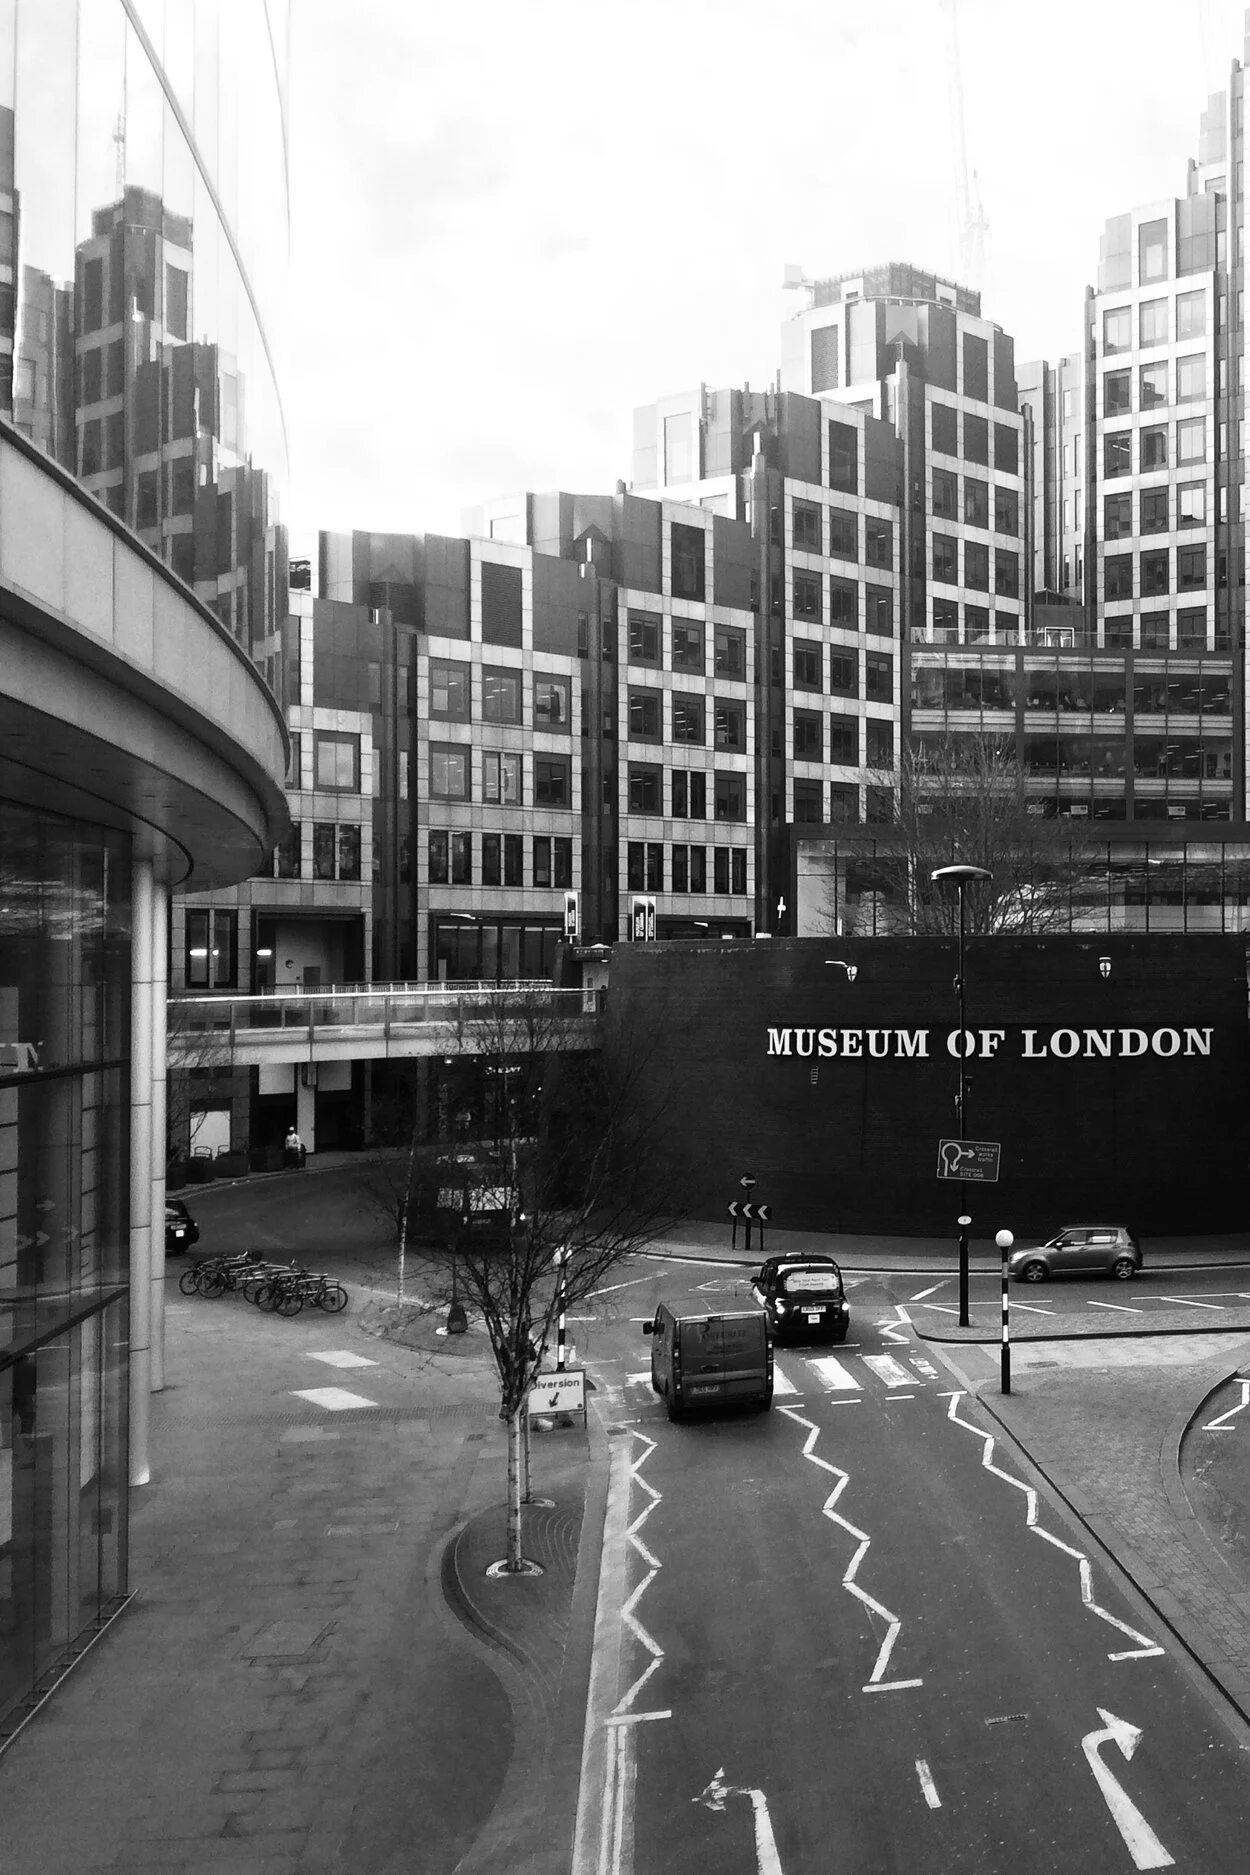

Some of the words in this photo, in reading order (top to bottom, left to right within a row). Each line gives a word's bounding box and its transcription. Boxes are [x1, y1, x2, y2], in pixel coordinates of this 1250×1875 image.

[766, 1027, 930, 1058] MUSEUM
[946, 1028, 1005, 1059] OF
[1021, 1027, 1215, 1058] LONDON
[534, 1378, 580, 1389] iversion
